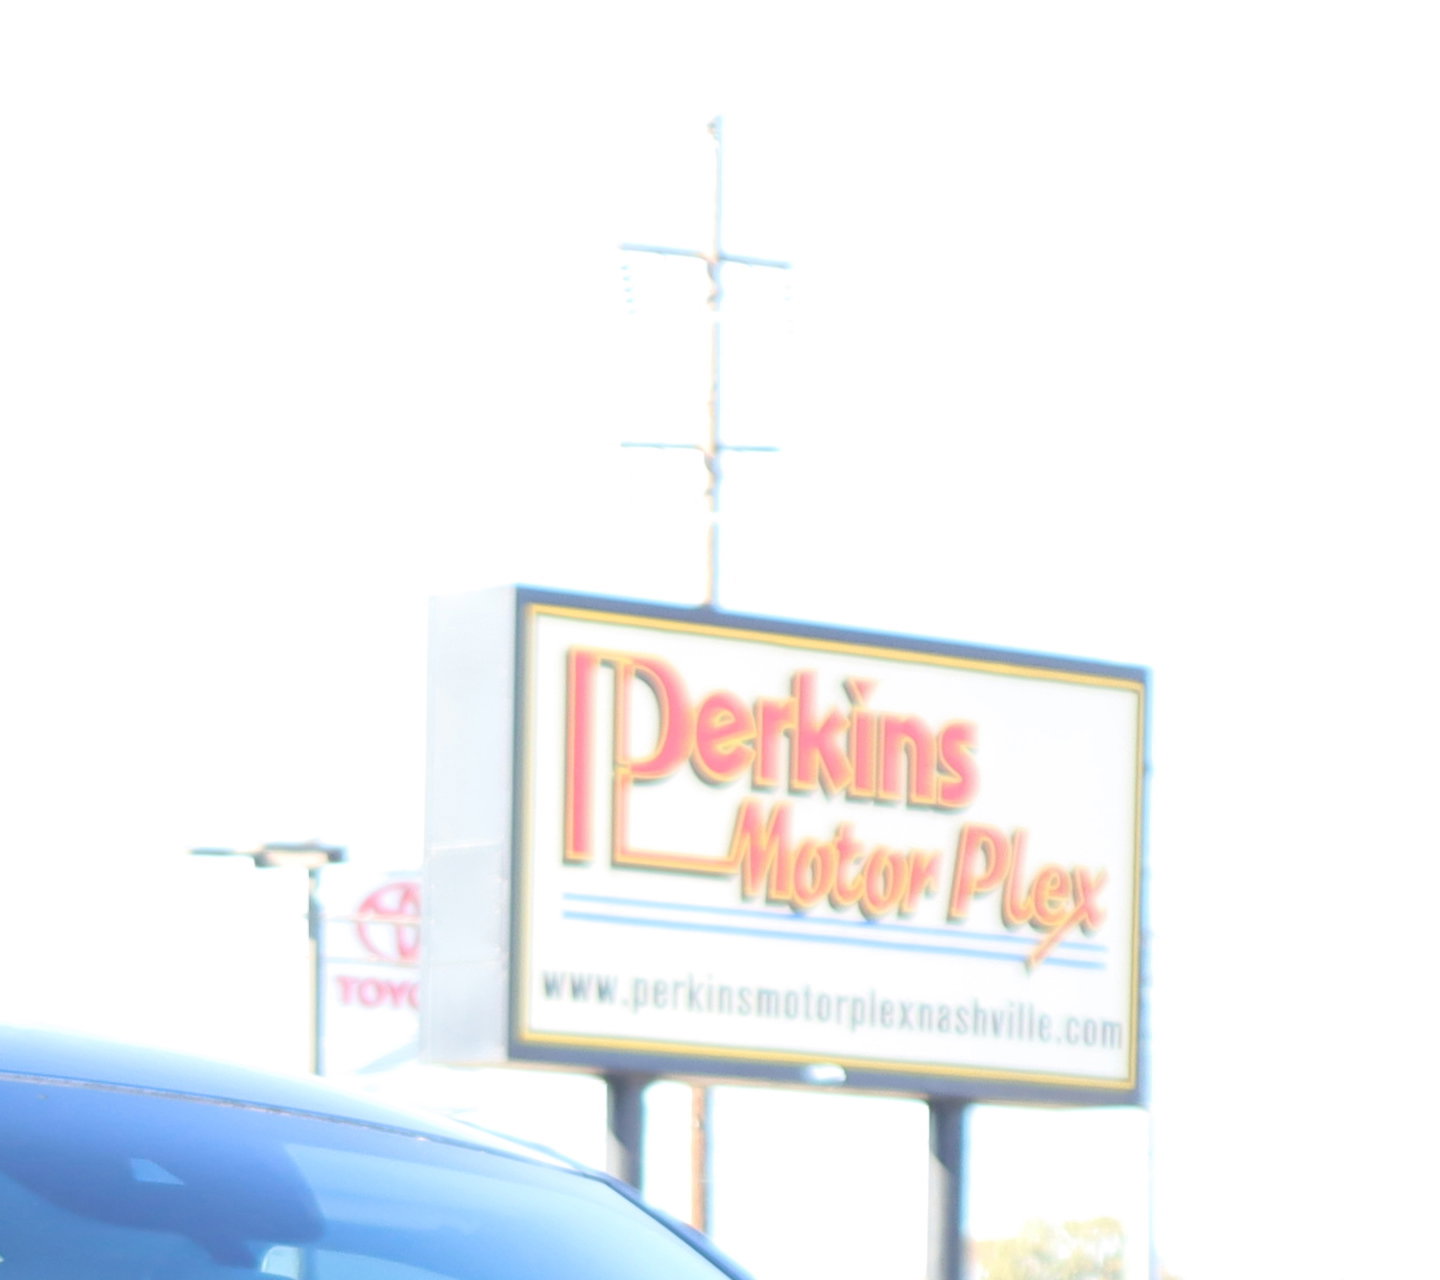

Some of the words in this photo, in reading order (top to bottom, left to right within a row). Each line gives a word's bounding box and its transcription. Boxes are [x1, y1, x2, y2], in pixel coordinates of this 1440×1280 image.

[563, 645, 980, 867] Perkins
[731, 799, 943, 922] Motor
[949, 825, 1110, 975] Plex
[541, 968, 1123, 1050] www.perkinsmotorplexnashville.com
